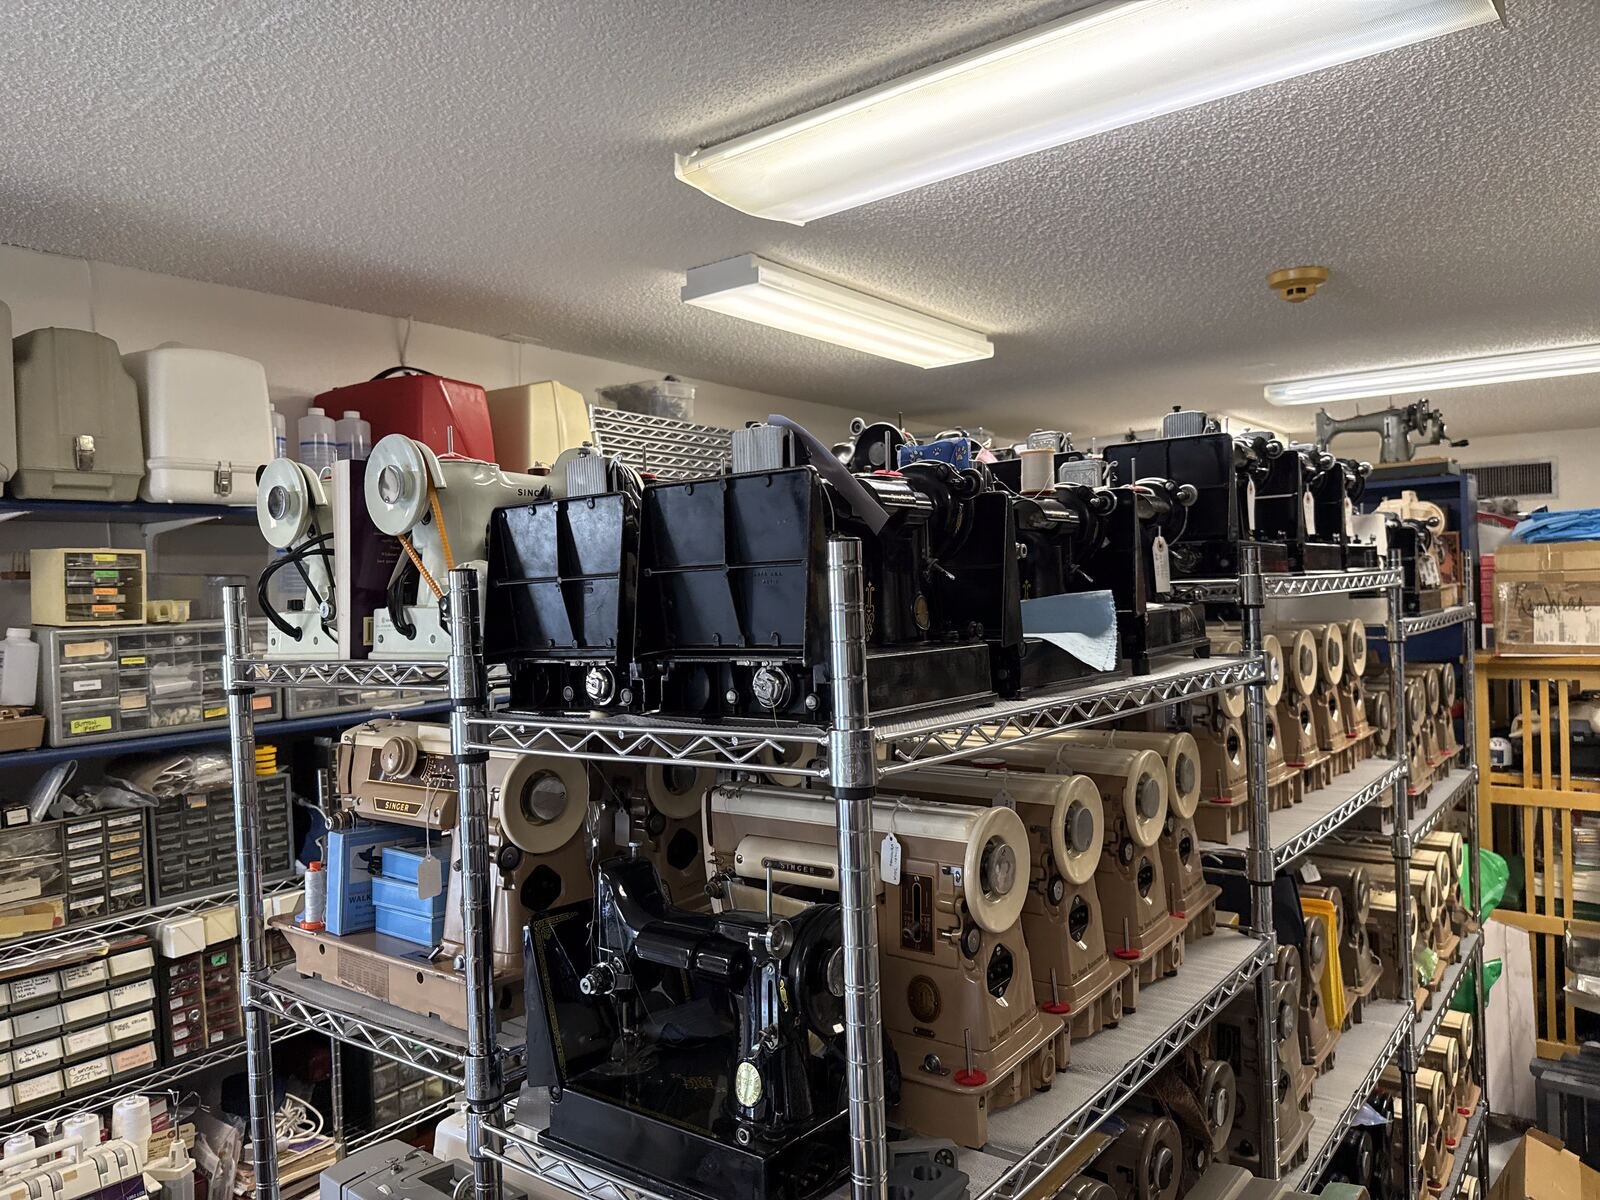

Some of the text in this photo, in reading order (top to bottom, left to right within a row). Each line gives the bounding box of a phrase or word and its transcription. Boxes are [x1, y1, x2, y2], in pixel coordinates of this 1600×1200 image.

[517, 488, 541, 497] SING
[385, 801, 409, 812] SINGER
[780, 863, 815, 873] SINGER
